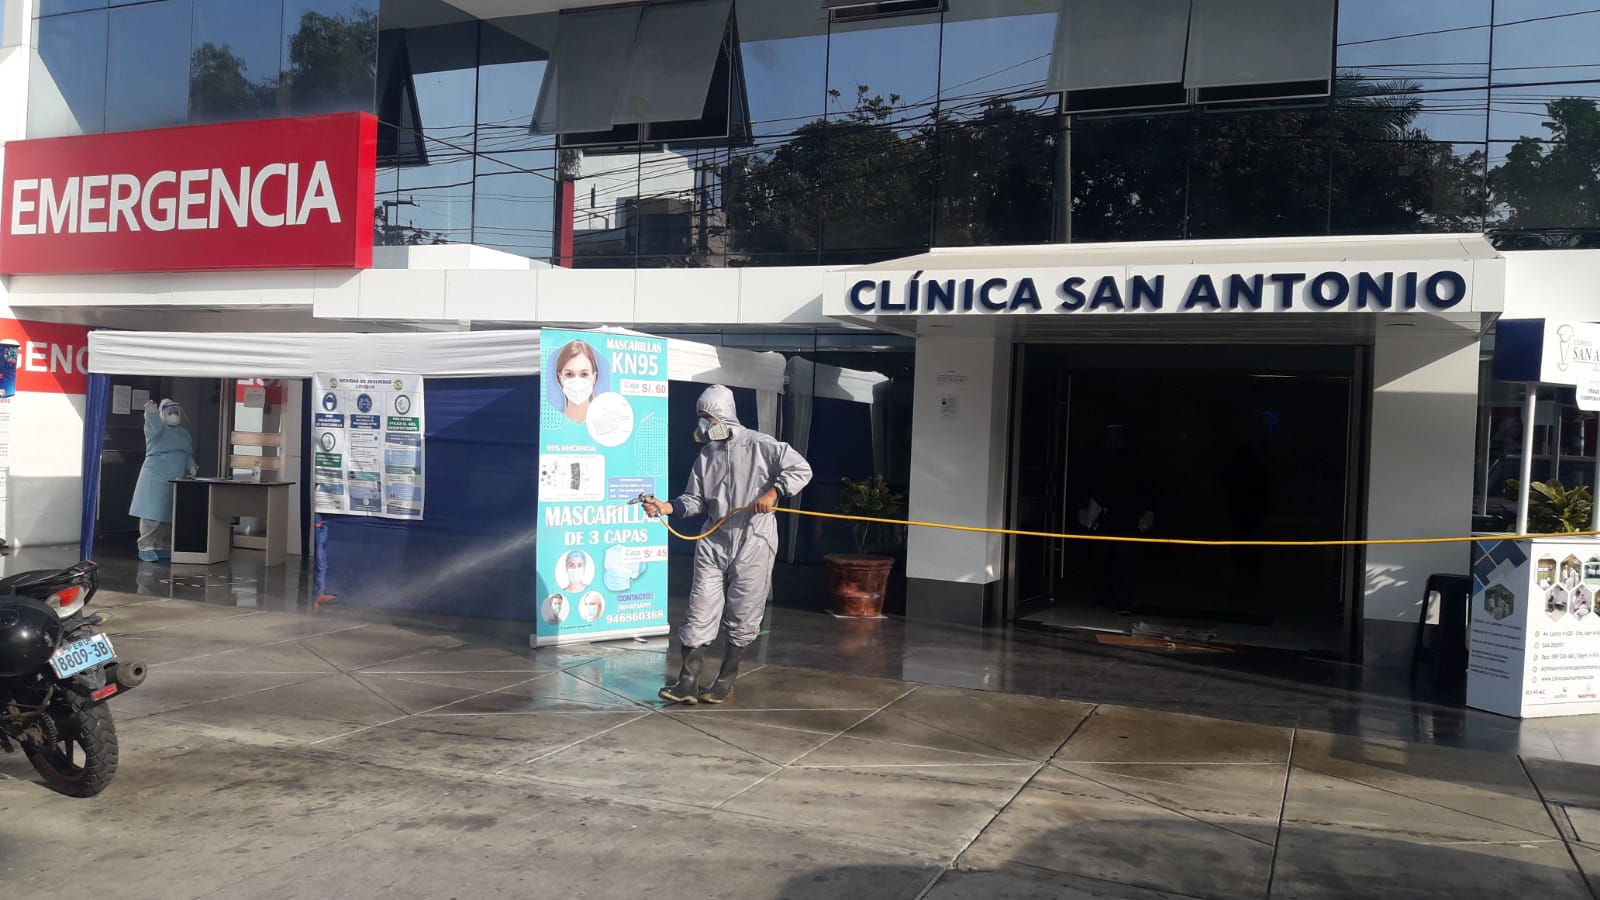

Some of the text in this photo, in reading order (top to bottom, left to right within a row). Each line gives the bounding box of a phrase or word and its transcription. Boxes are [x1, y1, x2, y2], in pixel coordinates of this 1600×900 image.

[11, 160, 341, 235] EMERGENCIA
[848, 270, 1466, 312] CLÍNICA SAN ANTONIO
[607, 340, 661, 353] MASCARILLAS
[1573, 347, 1592, 361] SAN
[612, 352, 659, 377] KN95
[624, 382, 640, 391] Caja
[655, 384, 666, 394] 60
[546, 506, 660, 526] MASCARILL
[564, 529, 648, 546] DE 3 CAPAS
[625, 549, 641, 557] Caja
[656, 549, 667, 558] 45
[619, 594, 651, 602] CONTACTO
[57, 641, 109, 671] 8809-3B
